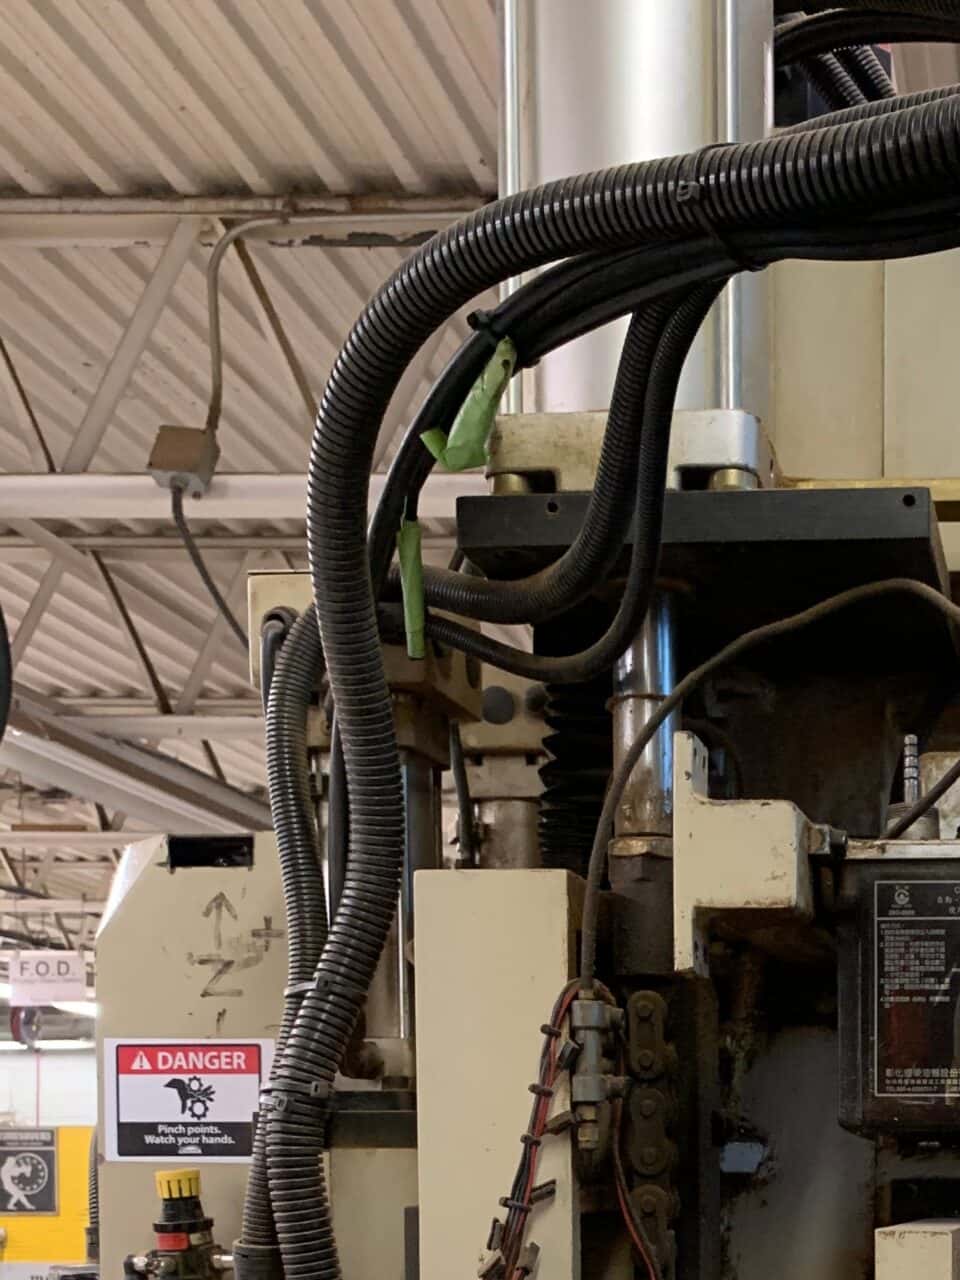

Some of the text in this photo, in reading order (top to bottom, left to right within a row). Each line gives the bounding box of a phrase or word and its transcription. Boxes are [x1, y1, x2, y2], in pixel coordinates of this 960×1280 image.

[157, 1052, 247, 1070] DANGER
[157, 1124, 221, 1136] Pinch points.
[144, 1134, 236, 1146] Watch your hands.
